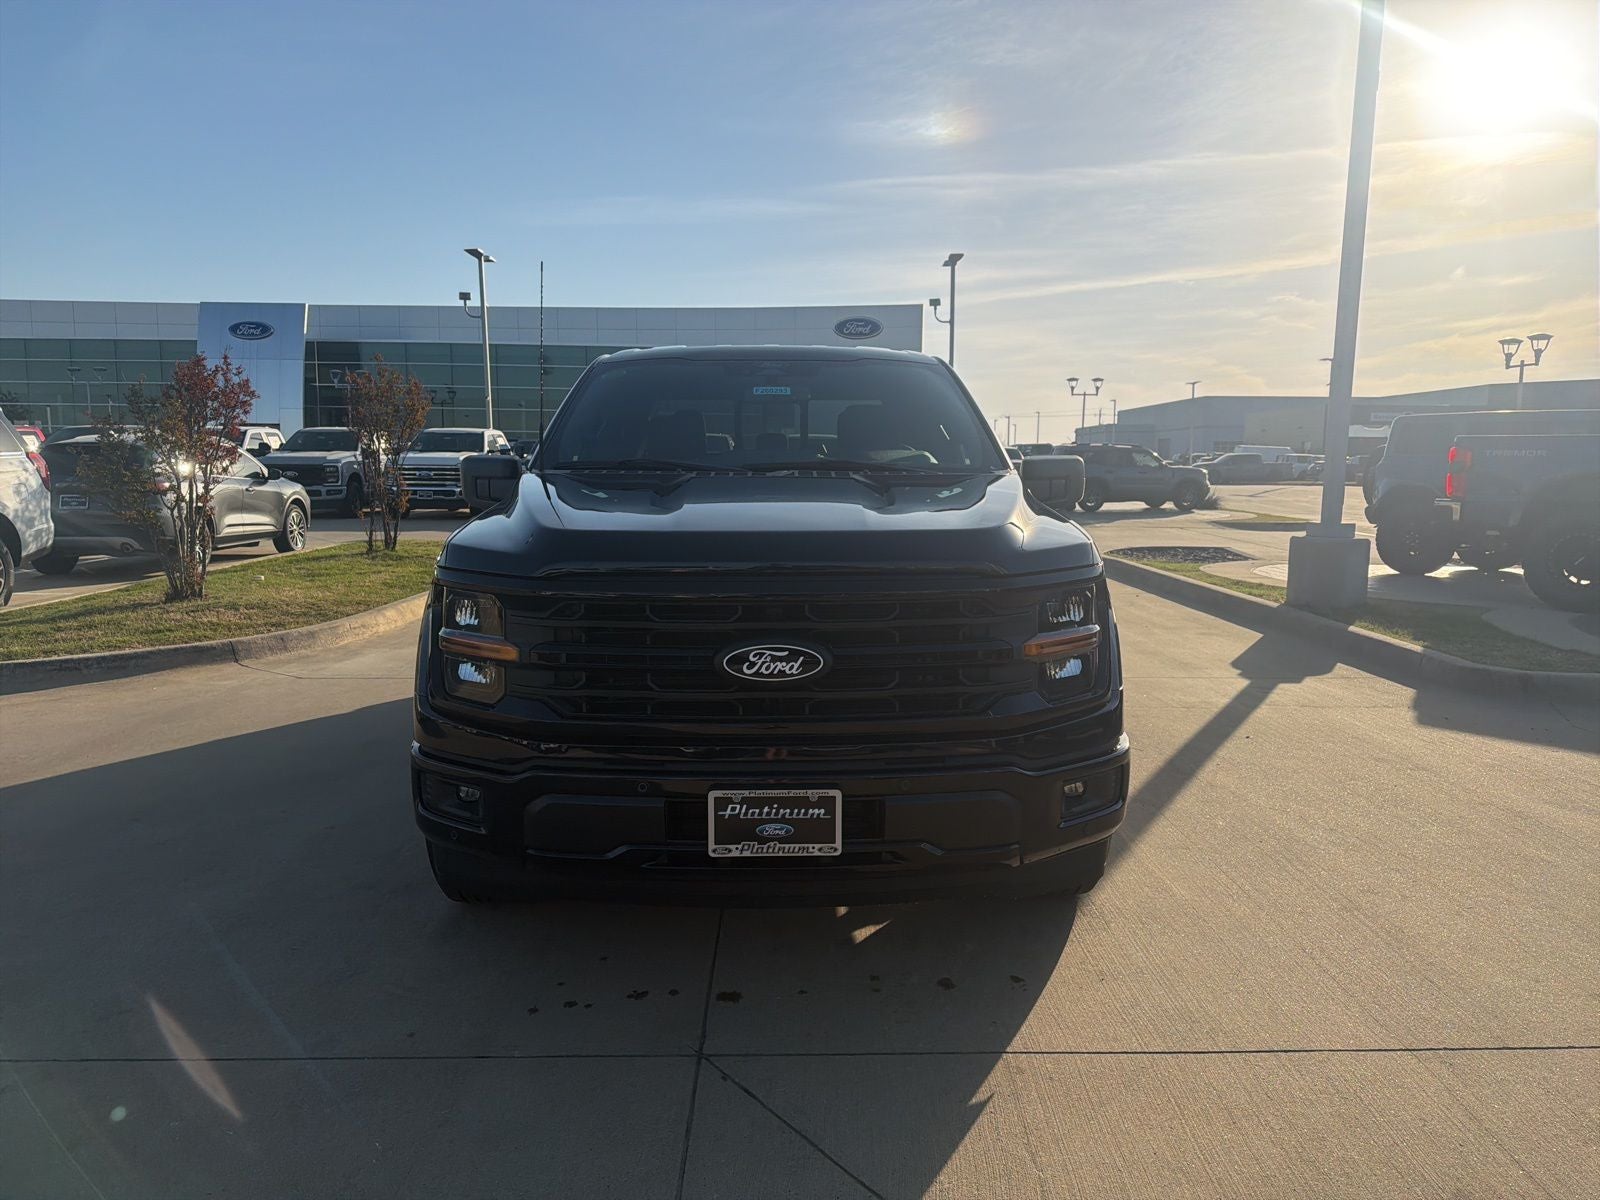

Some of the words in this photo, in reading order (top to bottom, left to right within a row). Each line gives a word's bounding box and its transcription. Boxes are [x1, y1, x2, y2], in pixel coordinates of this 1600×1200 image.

[237, 323, 262, 335] Ford
[843, 321, 872, 334] Ford
[742, 649, 805, 675] Ford
[718, 804, 831, 819] Platinum
[763, 824, 787, 836] Ford
[740, 841, 815, 855] Platinum
